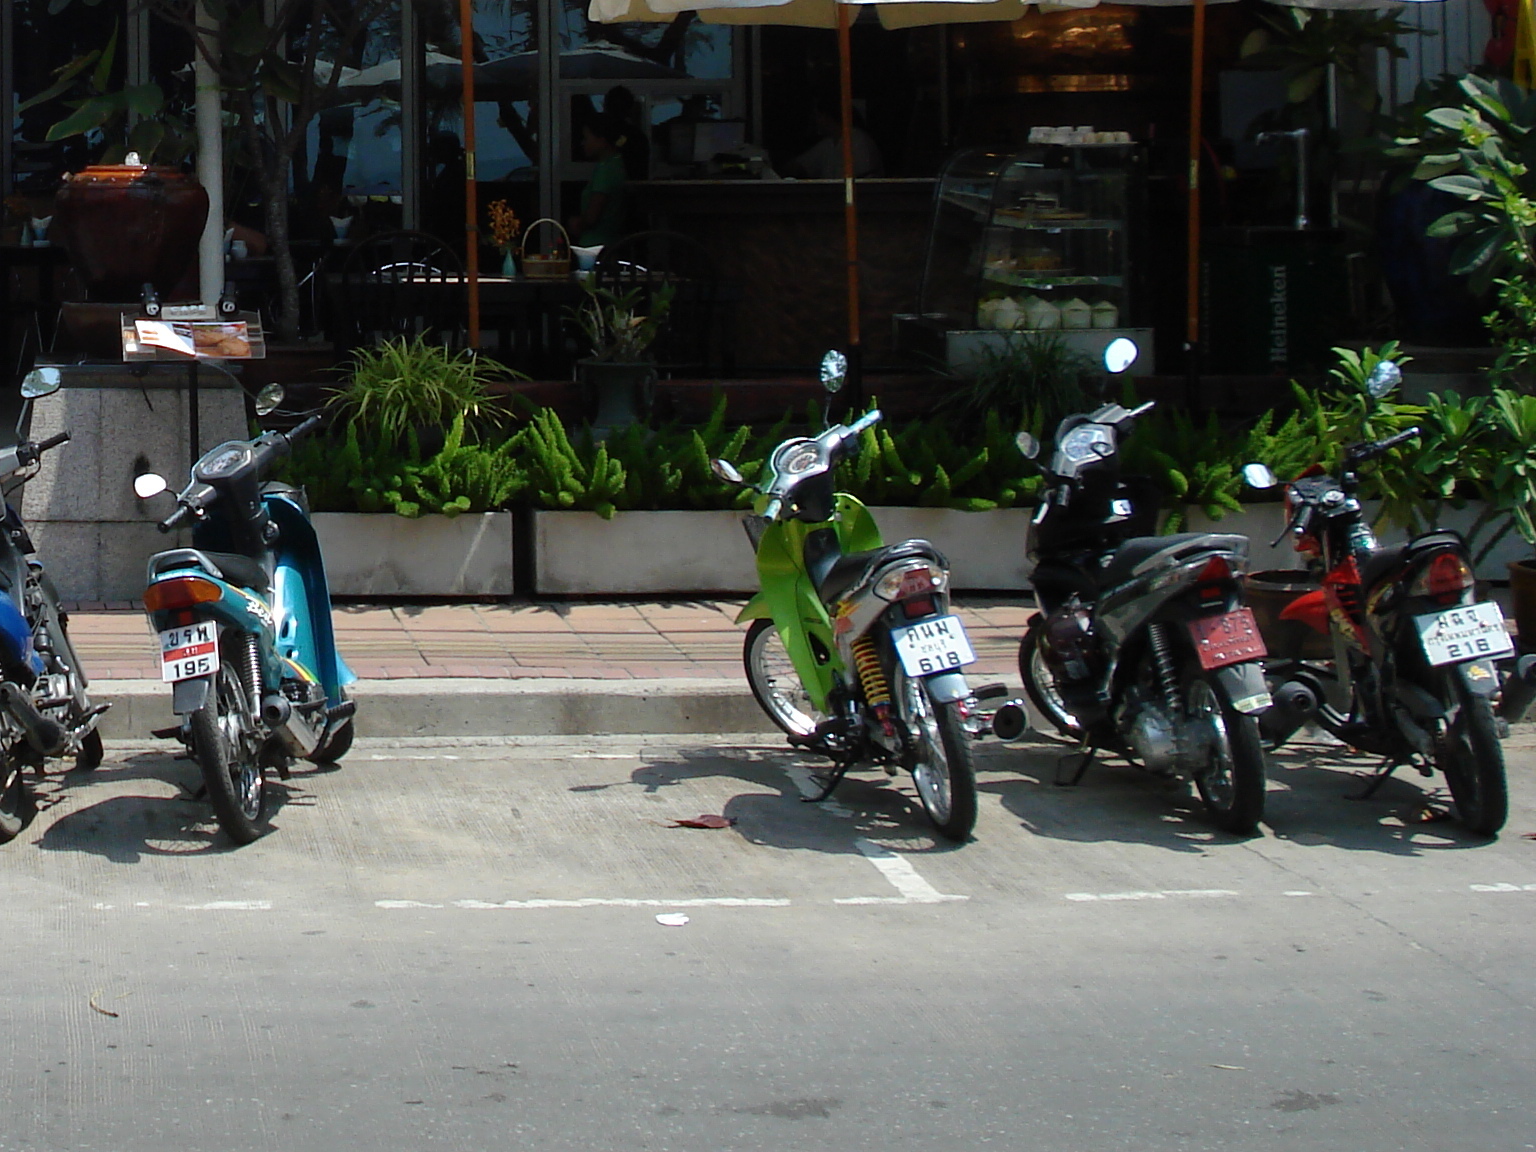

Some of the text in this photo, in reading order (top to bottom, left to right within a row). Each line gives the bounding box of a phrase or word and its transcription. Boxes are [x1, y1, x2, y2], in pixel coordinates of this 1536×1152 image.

[1268, 265, 1288, 362] Heineken
[173, 657, 210, 678] 195
[918, 651, 961, 672] 618
